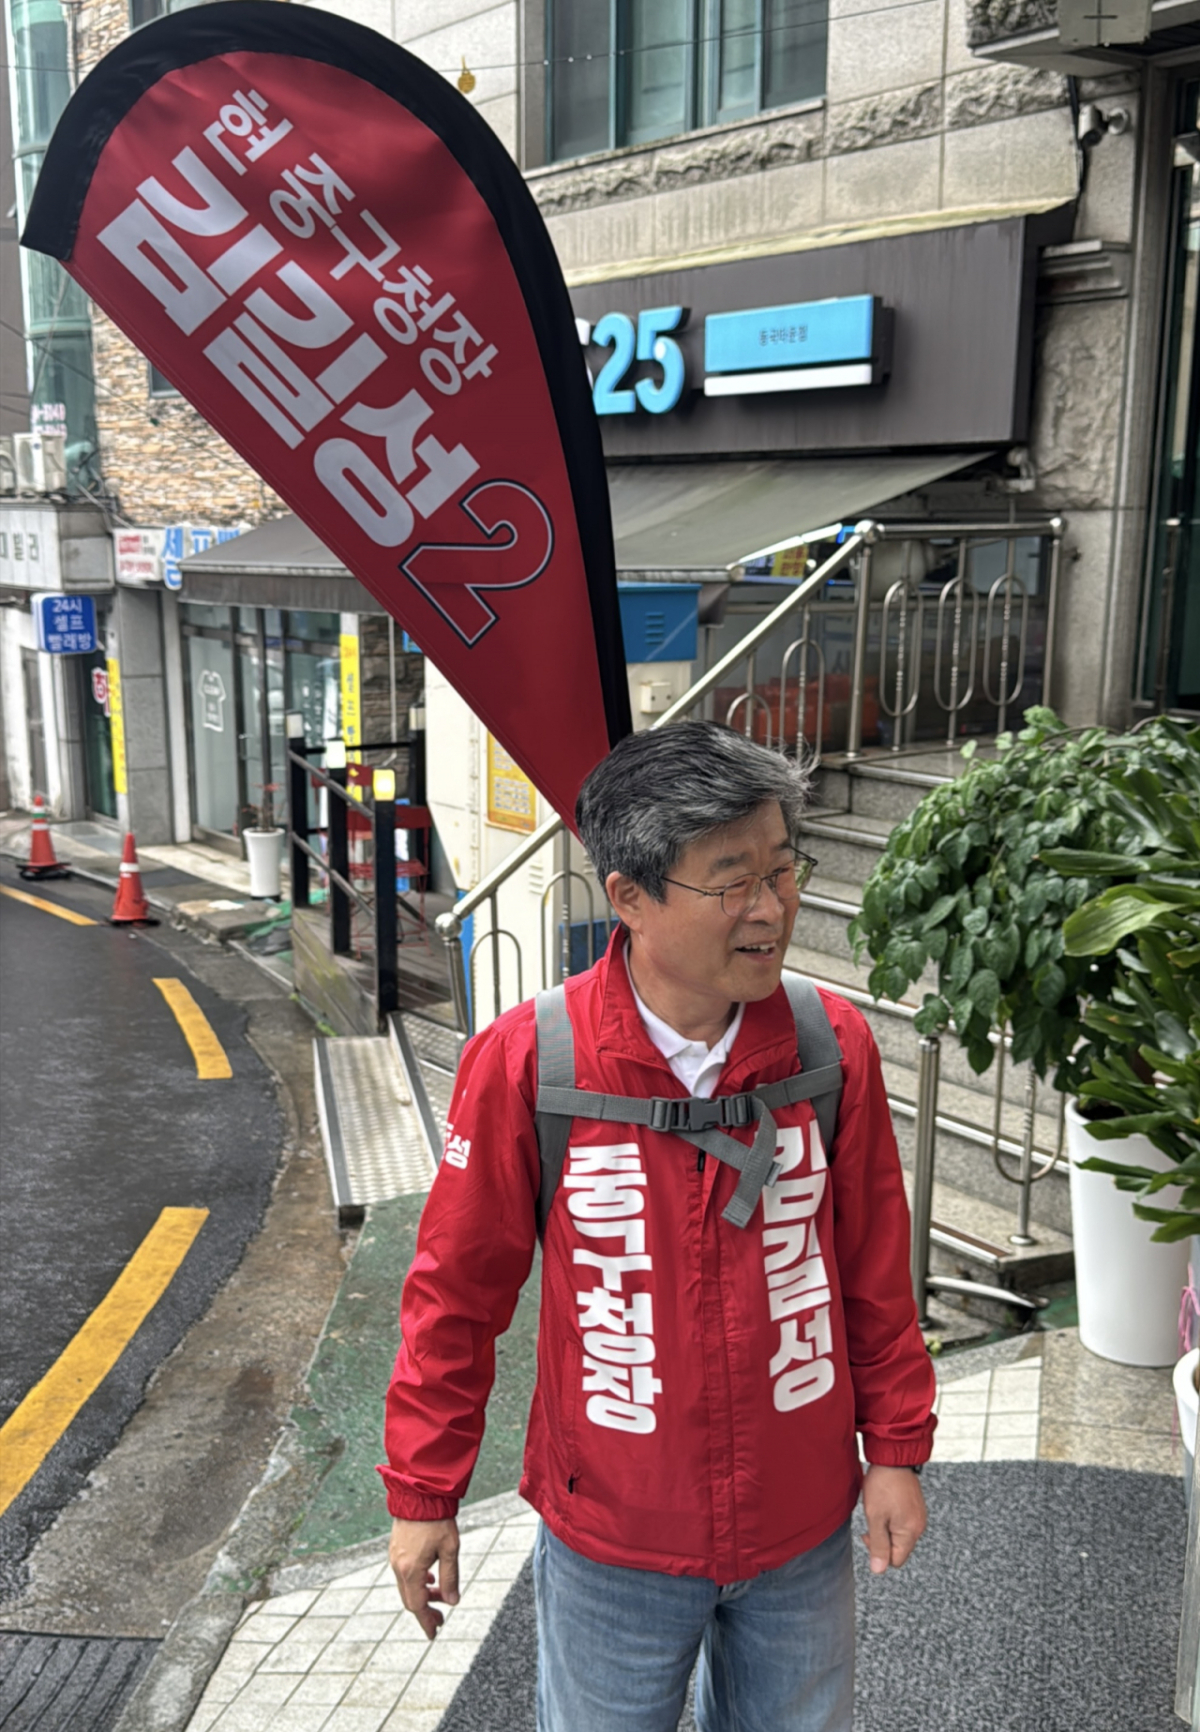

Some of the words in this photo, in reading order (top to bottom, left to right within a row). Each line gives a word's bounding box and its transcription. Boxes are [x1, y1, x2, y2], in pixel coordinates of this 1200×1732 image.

[203, 89, 294, 176] 현
[269, 152, 498, 396] 중구청장
[96, 145, 480, 548] 김길성
[48, 632, 92, 651] 빨래방
[51, 598, 83, 613] 24시
[53, 614, 85, 632] 셀프
[398, 477, 556, 649] 2
[563, 1143, 663, 1434] 중구청장
